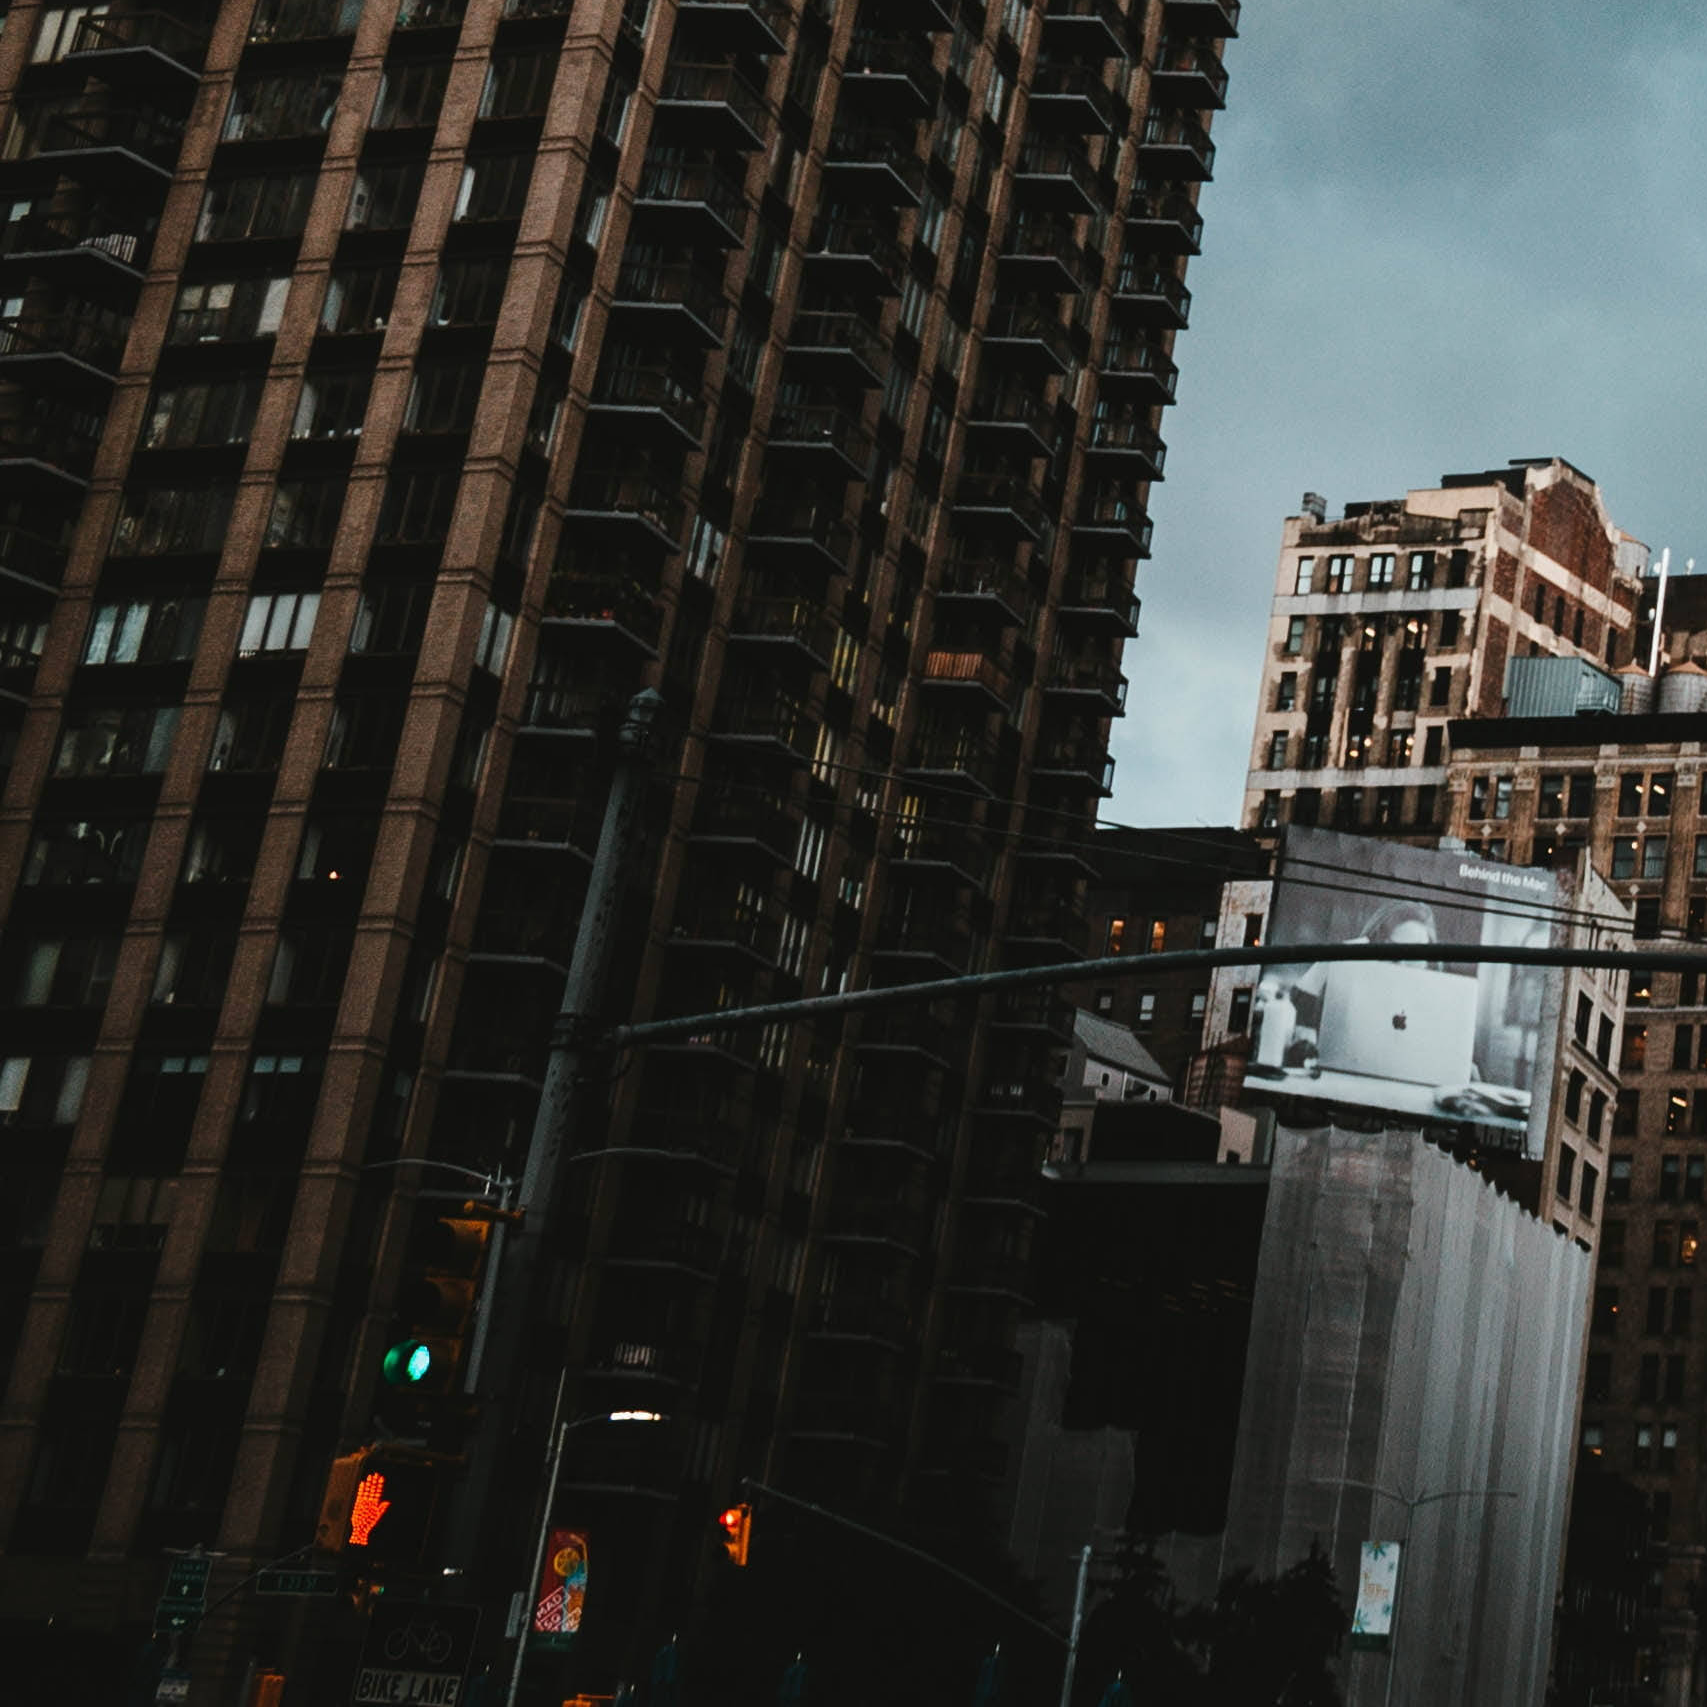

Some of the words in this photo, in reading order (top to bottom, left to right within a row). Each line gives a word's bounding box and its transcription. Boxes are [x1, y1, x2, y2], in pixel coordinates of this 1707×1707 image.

[1459, 863, 1501, 884] Behind
[1502, 871, 1522, 887] the
[1522, 875, 1549, 892] Mac
[357, 1671, 403, 1700] BIKE
[407, 1674, 459, 1705] LANE
